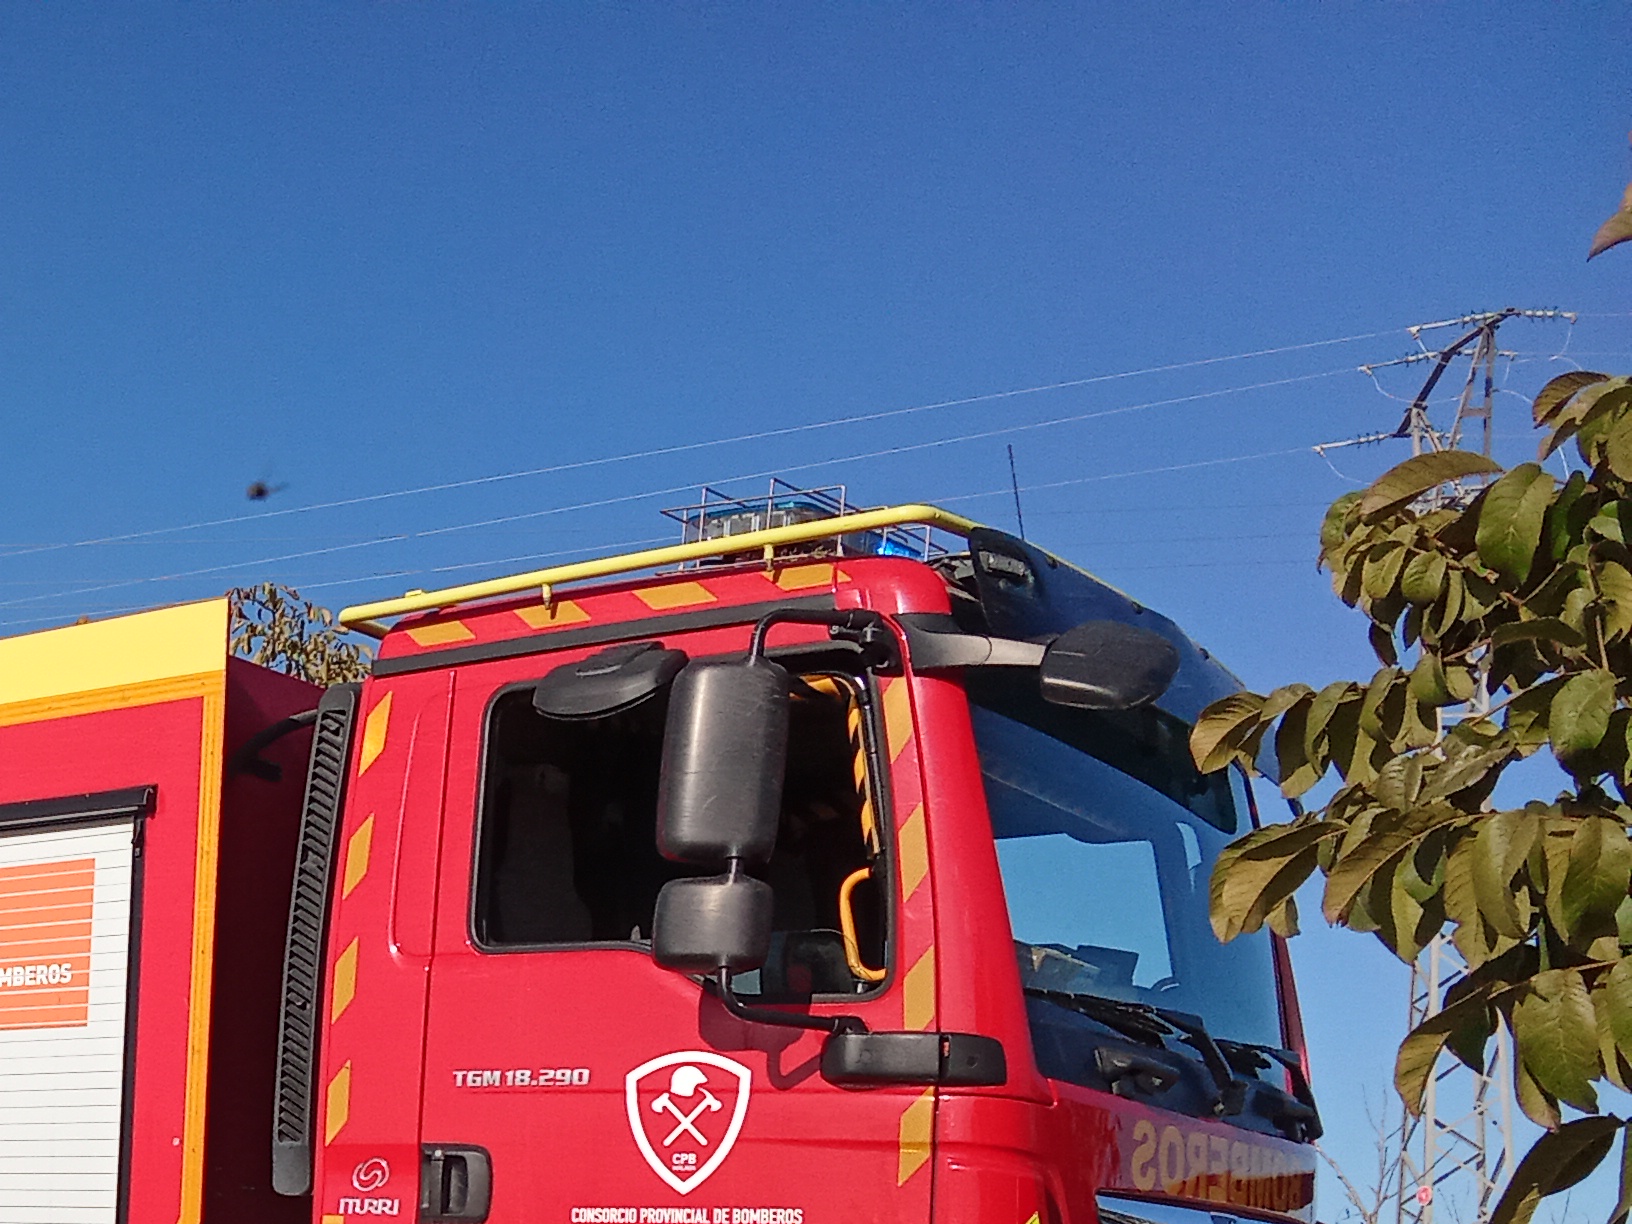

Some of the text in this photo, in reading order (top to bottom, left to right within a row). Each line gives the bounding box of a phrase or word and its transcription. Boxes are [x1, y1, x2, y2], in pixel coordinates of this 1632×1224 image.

[452, 1068, 590, 1087] TGM 18.290
[671, 1152, 697, 1165] CPB
[570, 1206, 637, 1224] CONSORCIO
[639, 1207, 711, 1224] PROVINCIAL
[713, 1208, 730, 1224] DE
